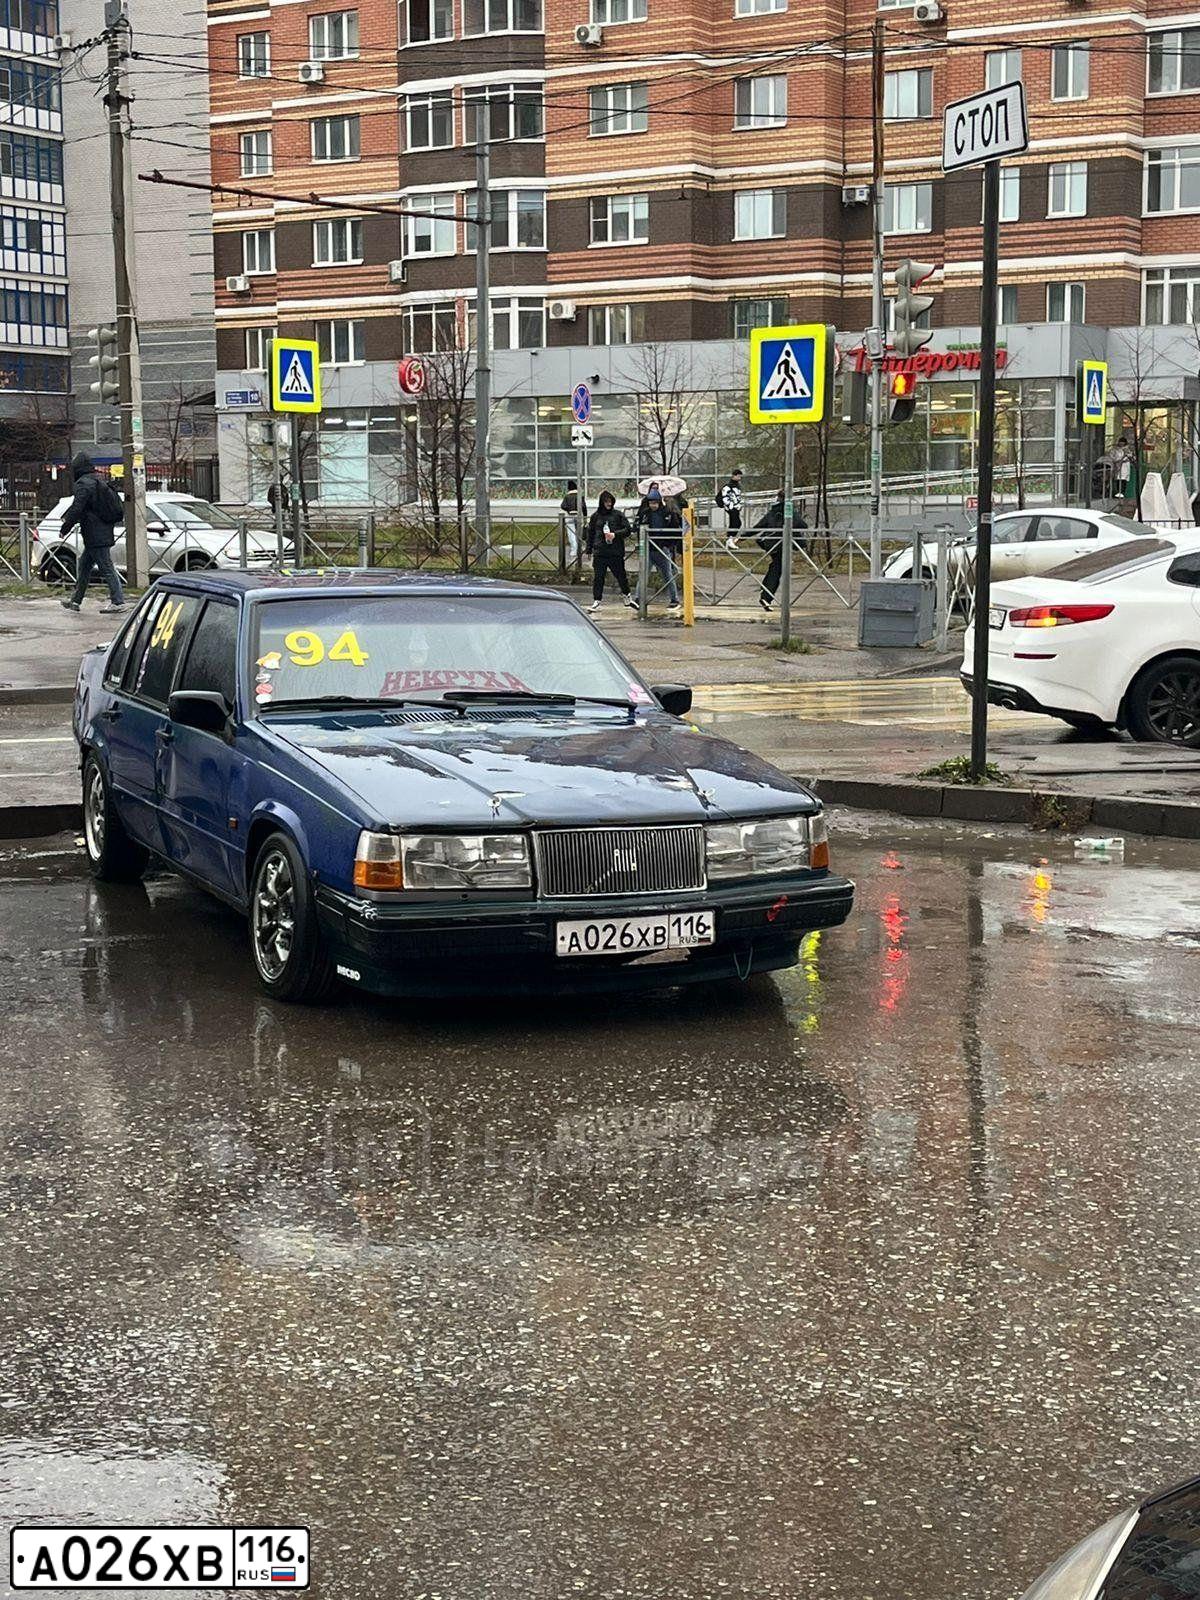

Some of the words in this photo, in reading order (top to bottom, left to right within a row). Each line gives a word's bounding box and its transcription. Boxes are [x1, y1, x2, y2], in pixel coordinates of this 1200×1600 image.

[954, 98, 1009, 155] СТОП
[151, 601, 184, 650] 94
[284, 630, 369, 667] 94
[379, 670, 534, 697] НЕКРУХА
[568, 922, 667, 953] А026ХВ
[672, 915, 704, 936] 116
[679, 935, 697, 944] RUS
